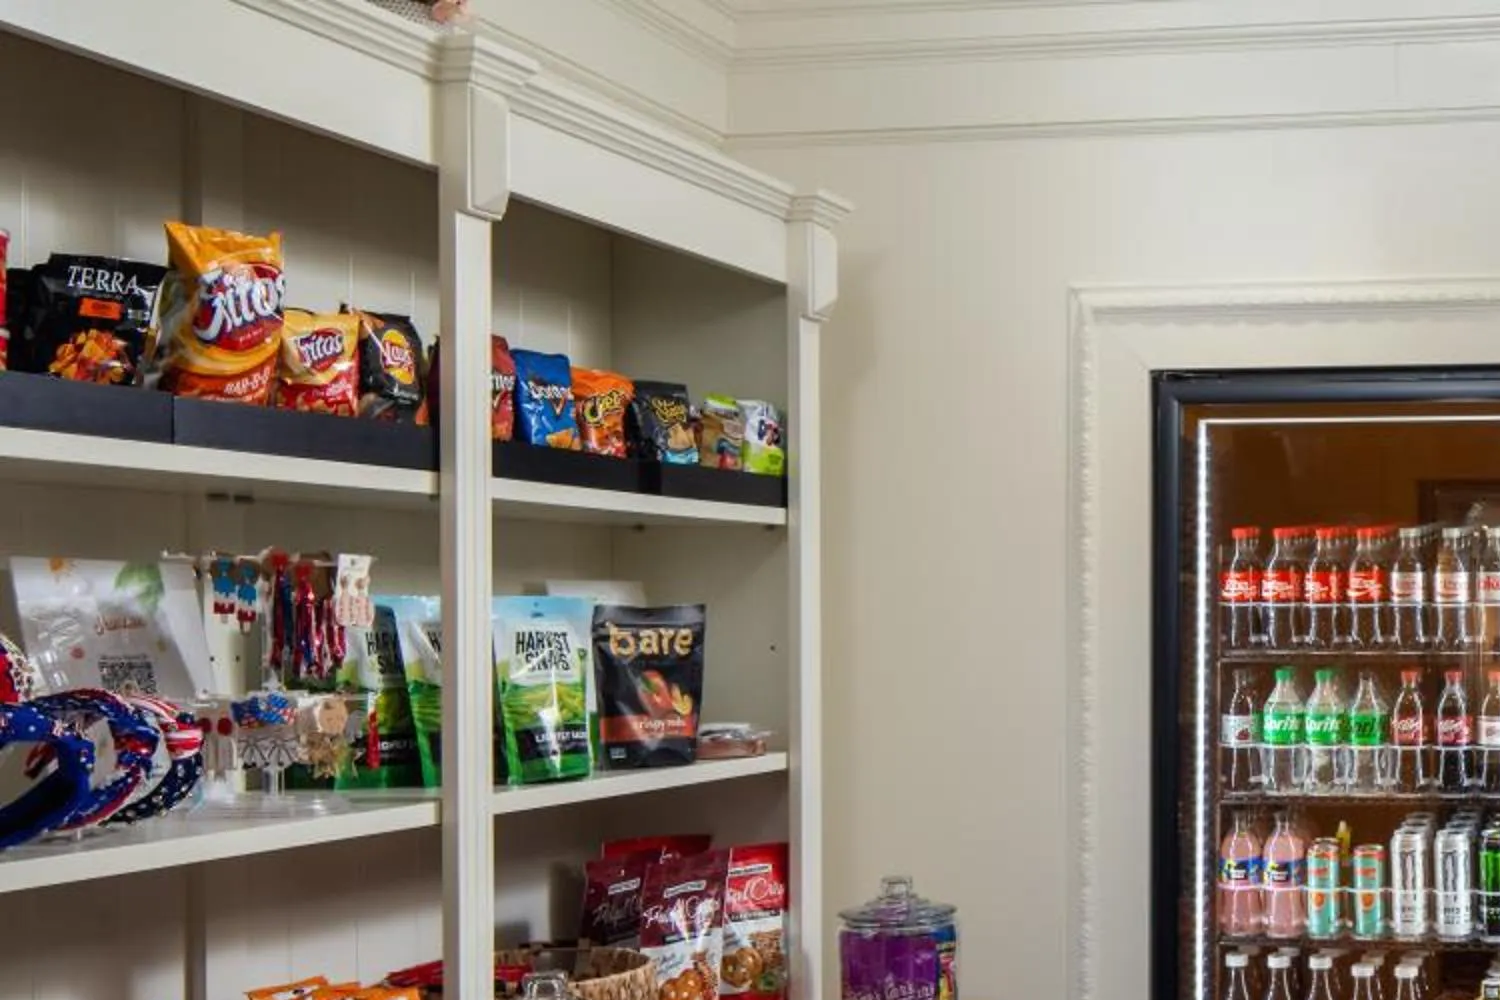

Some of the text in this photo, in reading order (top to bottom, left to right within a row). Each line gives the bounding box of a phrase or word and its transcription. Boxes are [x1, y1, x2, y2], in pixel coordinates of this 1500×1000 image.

[67, 264, 140, 295] TERRA
[292, 331, 344, 367] Fritos
[609, 621, 694, 661] bare
